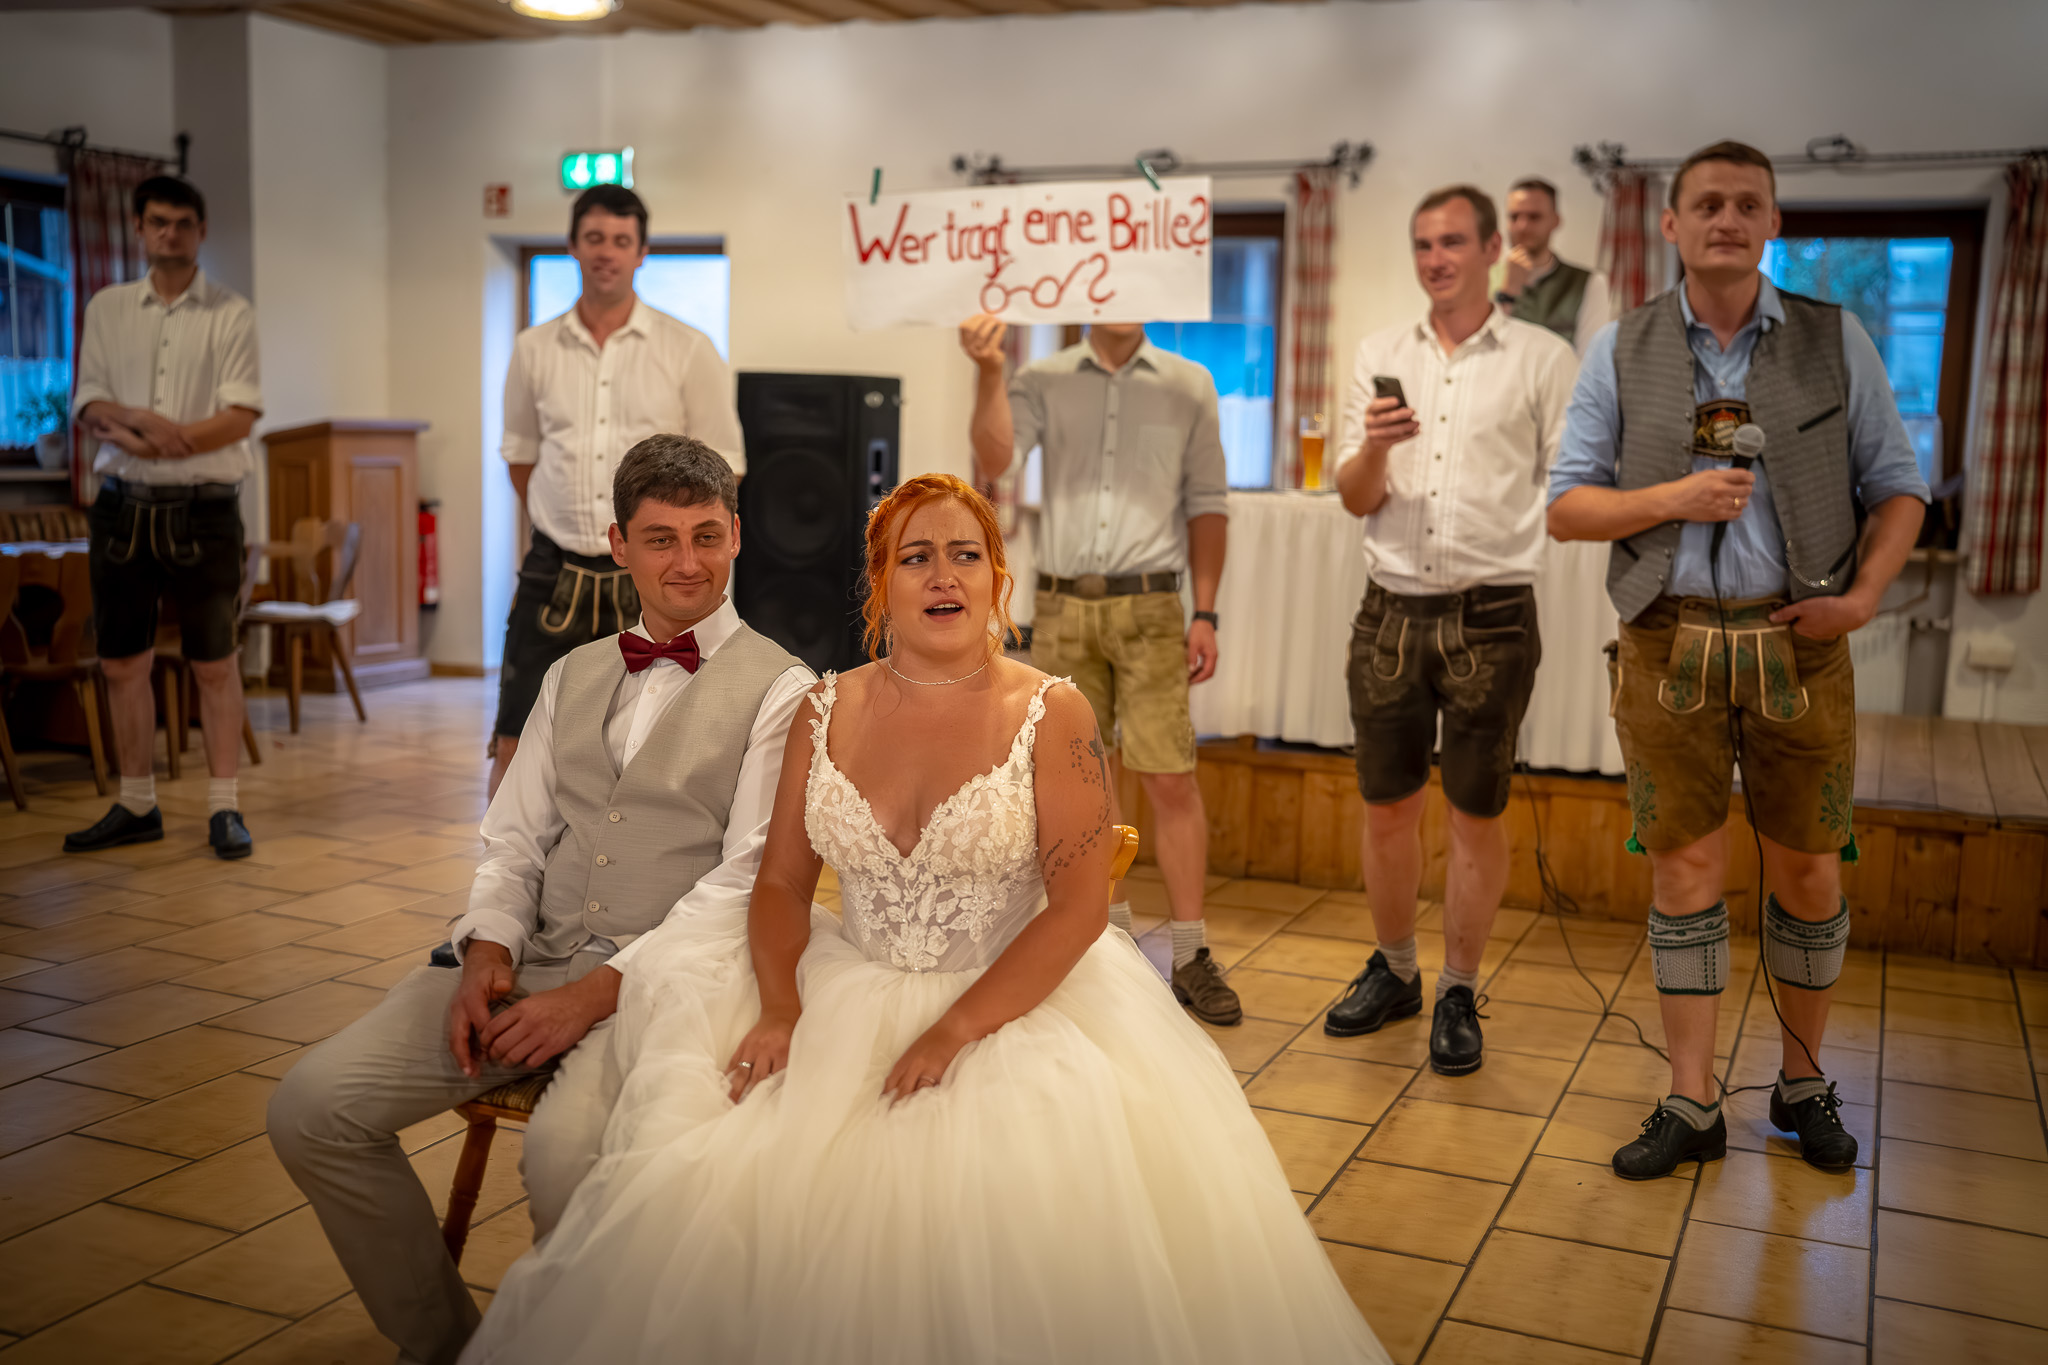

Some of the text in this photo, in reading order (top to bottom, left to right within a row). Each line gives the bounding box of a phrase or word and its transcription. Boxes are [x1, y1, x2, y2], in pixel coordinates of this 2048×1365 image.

[848, 193, 1211, 279] Wer trägt eine Brille?
